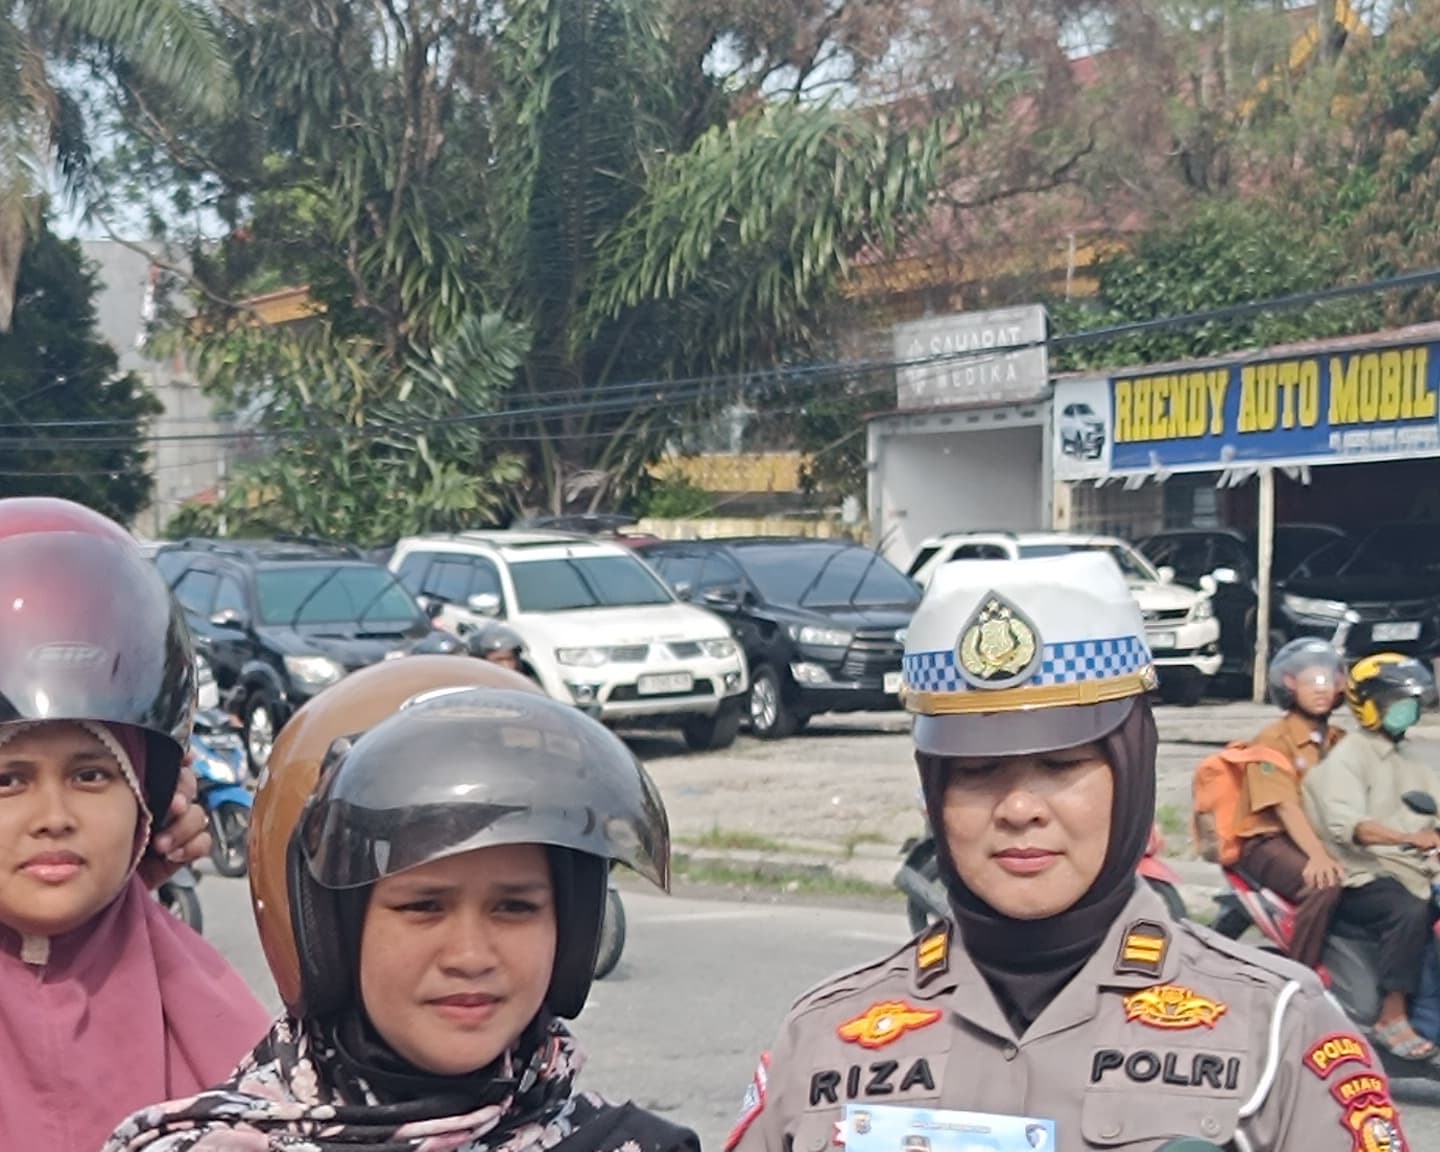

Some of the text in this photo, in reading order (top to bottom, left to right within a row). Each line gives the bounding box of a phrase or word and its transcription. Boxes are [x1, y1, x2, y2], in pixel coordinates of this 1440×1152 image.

[1114, 346, 1436, 443] RHENDY AUTO MOBIL
[809, 1058, 936, 1106] RIZA
[1091, 1049, 1241, 1090] POLRI
